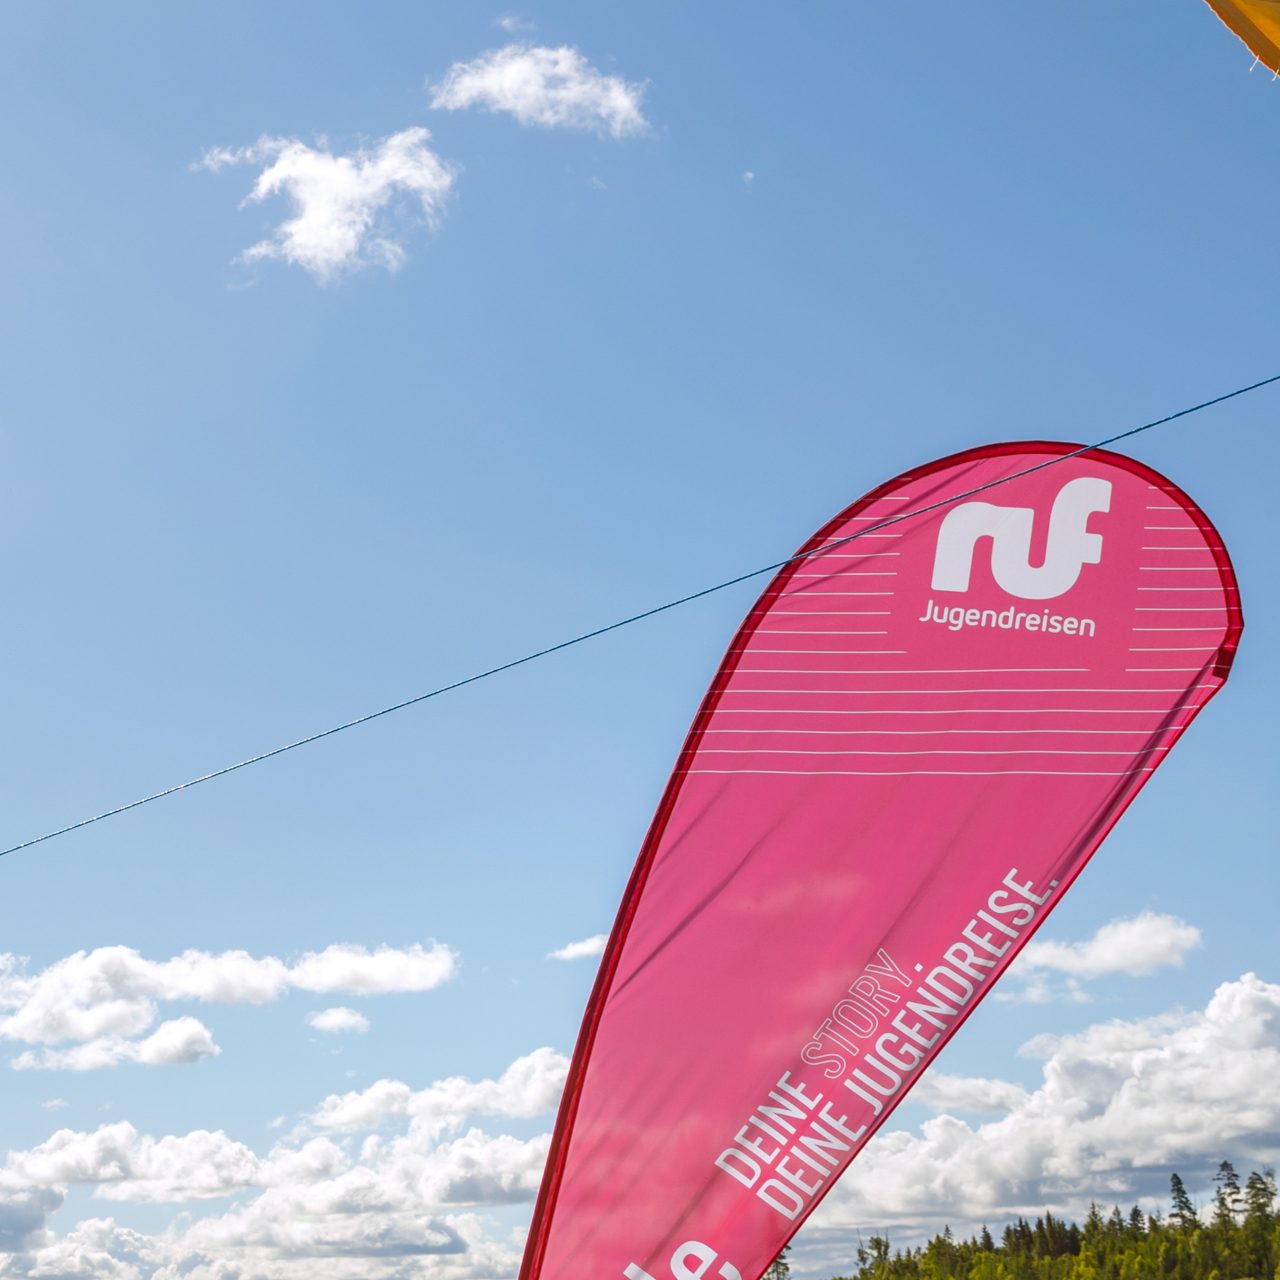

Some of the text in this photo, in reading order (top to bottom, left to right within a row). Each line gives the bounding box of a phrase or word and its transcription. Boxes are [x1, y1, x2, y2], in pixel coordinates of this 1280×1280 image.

[919, 600, 1096, 638] Jugendreisen
[931, 477, 1113, 600] ruf
[714, 947, 924, 1190] DEINE STORY.
[755, 867, 1060, 1221] DEINE JUGENDREISE.
